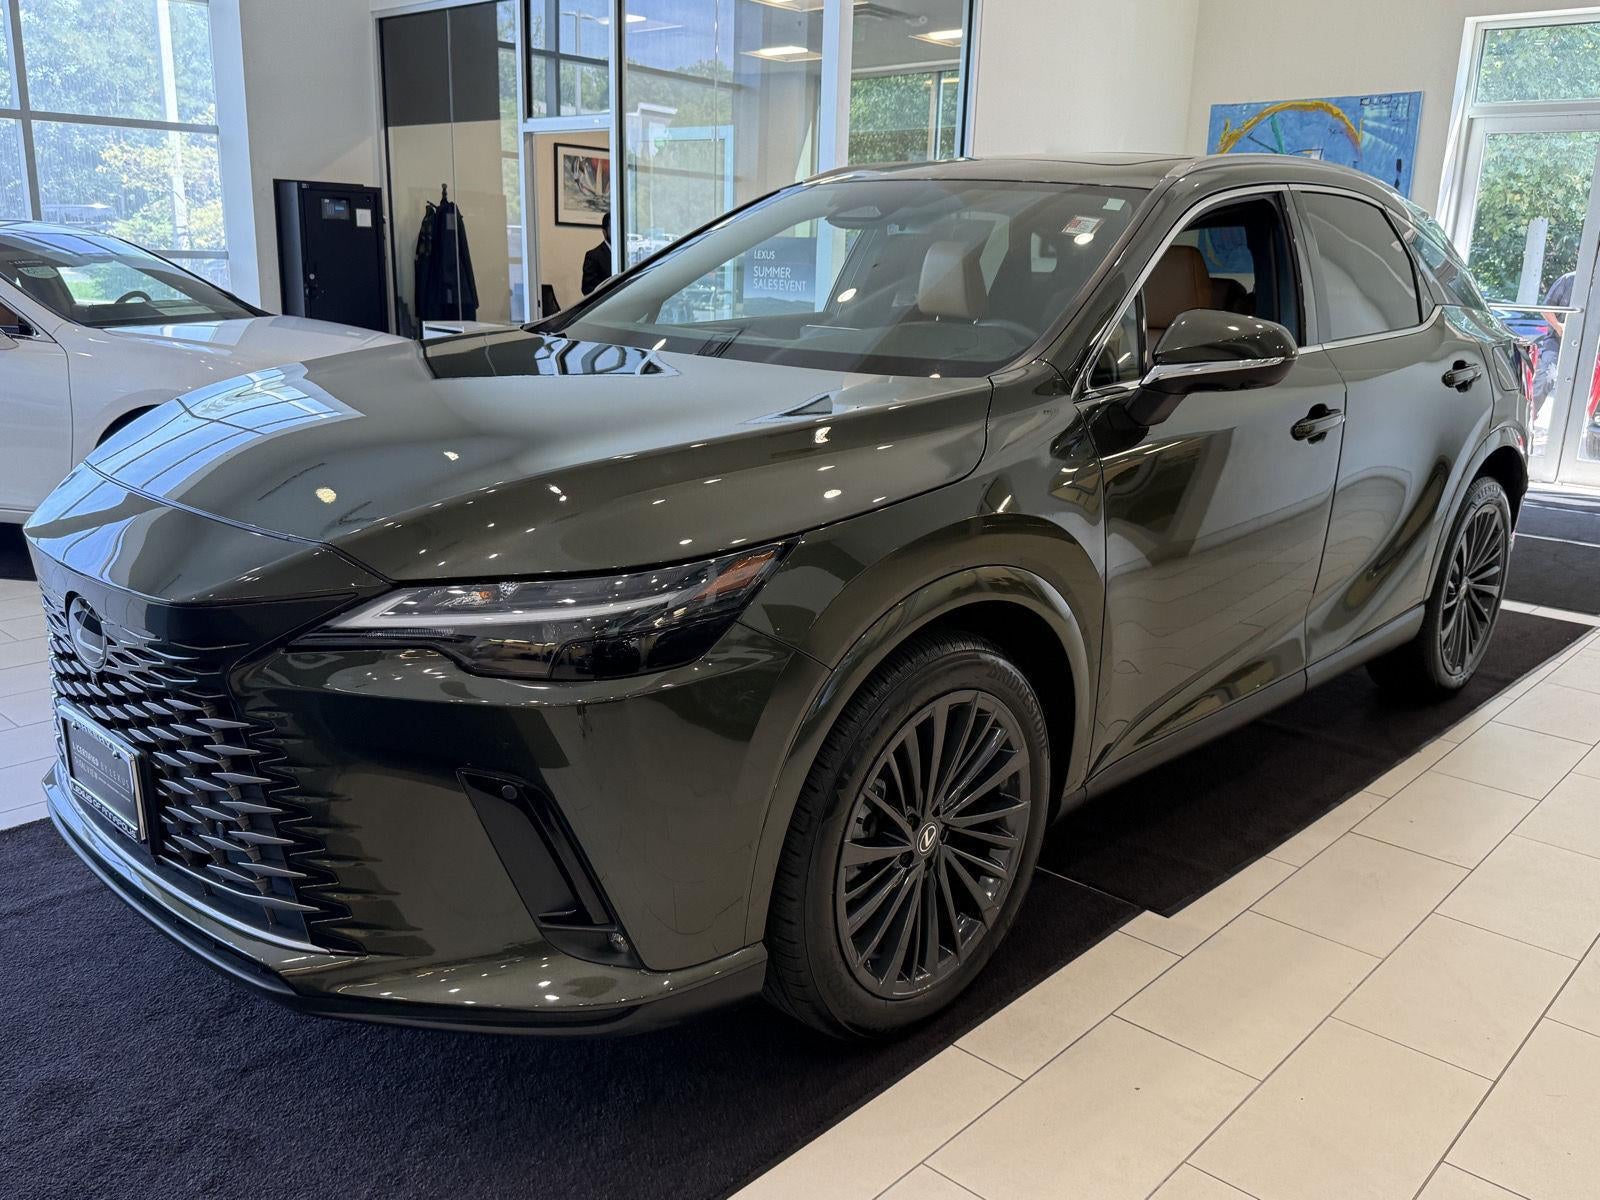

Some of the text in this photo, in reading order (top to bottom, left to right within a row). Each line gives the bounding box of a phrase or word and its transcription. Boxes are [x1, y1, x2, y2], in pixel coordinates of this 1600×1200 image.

[753, 248, 776, 260] LEXUS
[753, 265, 791, 279] SUMMER
[753, 278, 807, 292] SALES EVENT
[109, 768, 130, 790] LEXUS
[71, 782, 93, 804] LEXUS
[92, 799, 102, 809] OF
